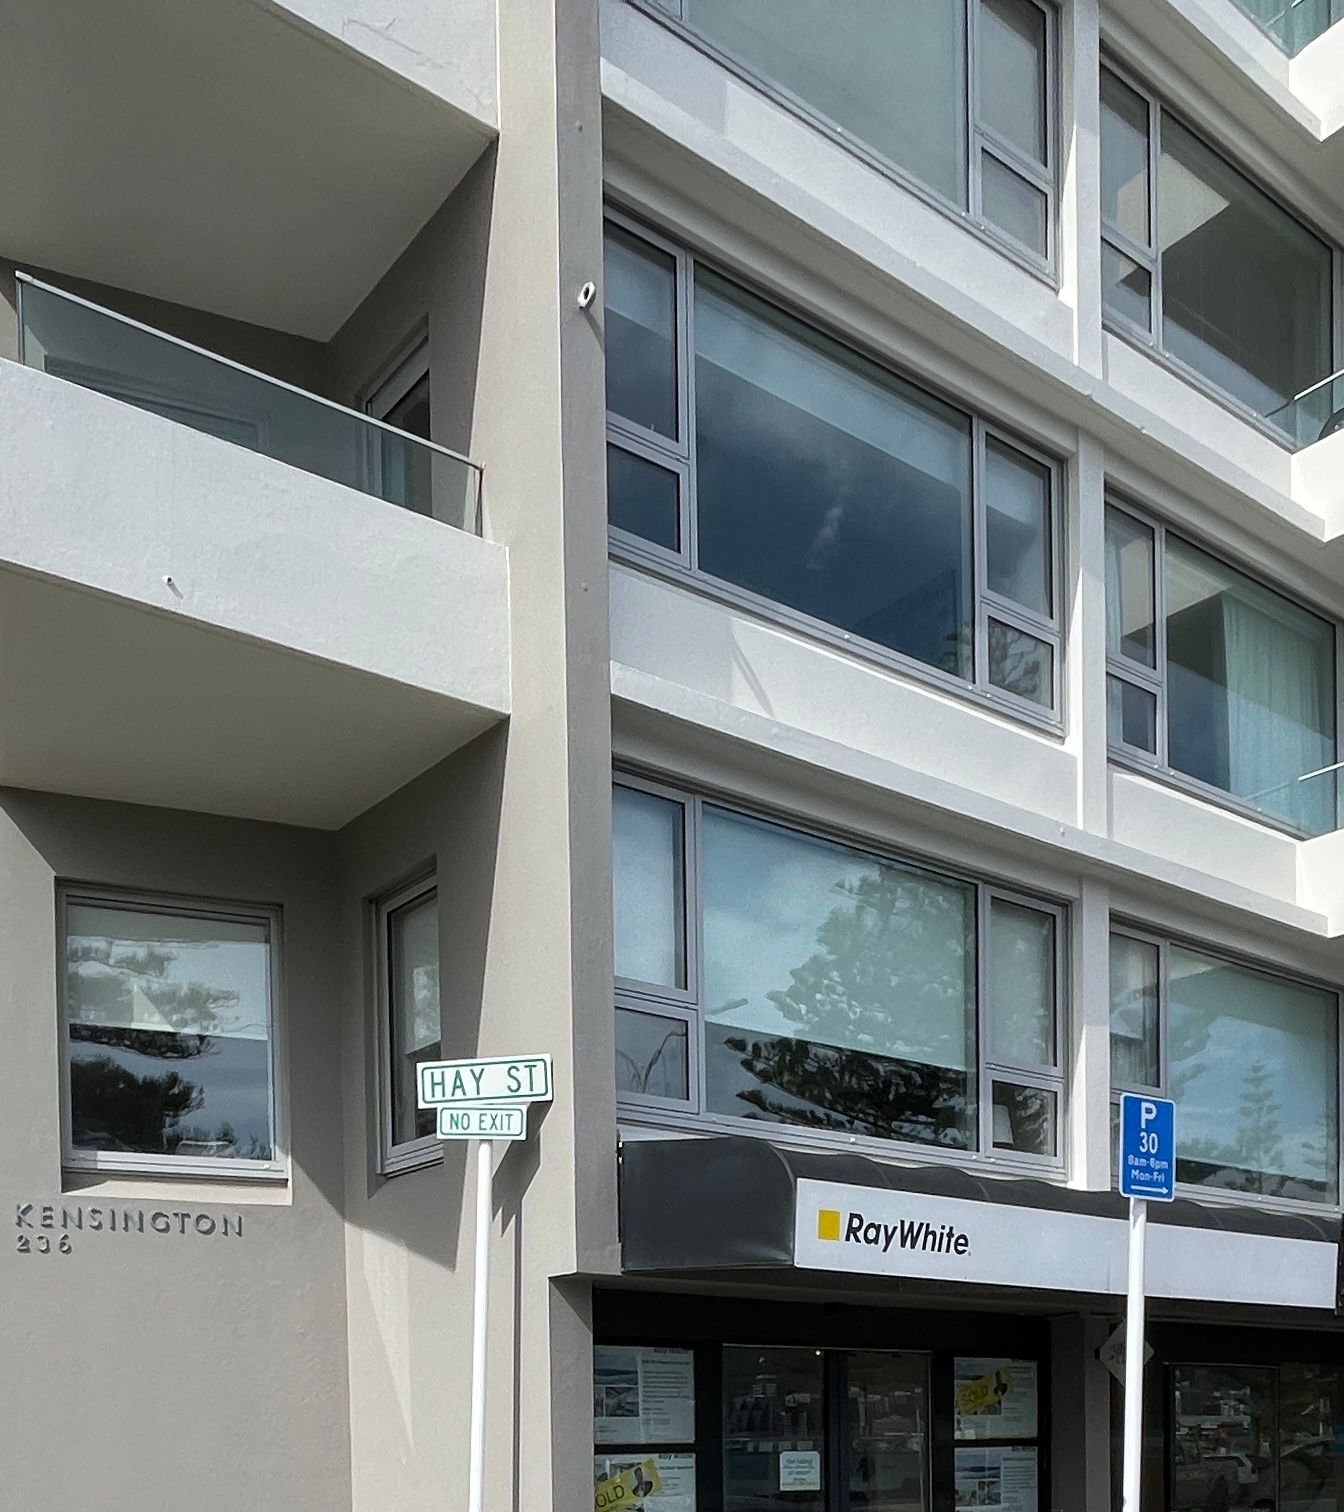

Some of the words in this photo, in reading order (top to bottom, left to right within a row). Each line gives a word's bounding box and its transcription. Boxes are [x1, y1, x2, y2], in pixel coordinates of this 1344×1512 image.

[429, 1067, 485, 1099] HAY
[506, 1064, 538, 1093] ST
[449, 1112, 471, 1131] NO
[478, 1112, 514, 1131] EXIT
[1140, 1101, 1158, 1129] P
[1139, 1131, 1159, 1154] 30
[1130, 1168, 1166, 1184] Mon-Fri
[15, 1202, 244, 1238] KENSINGTON
[16, 1234, 73, 1255] 236
